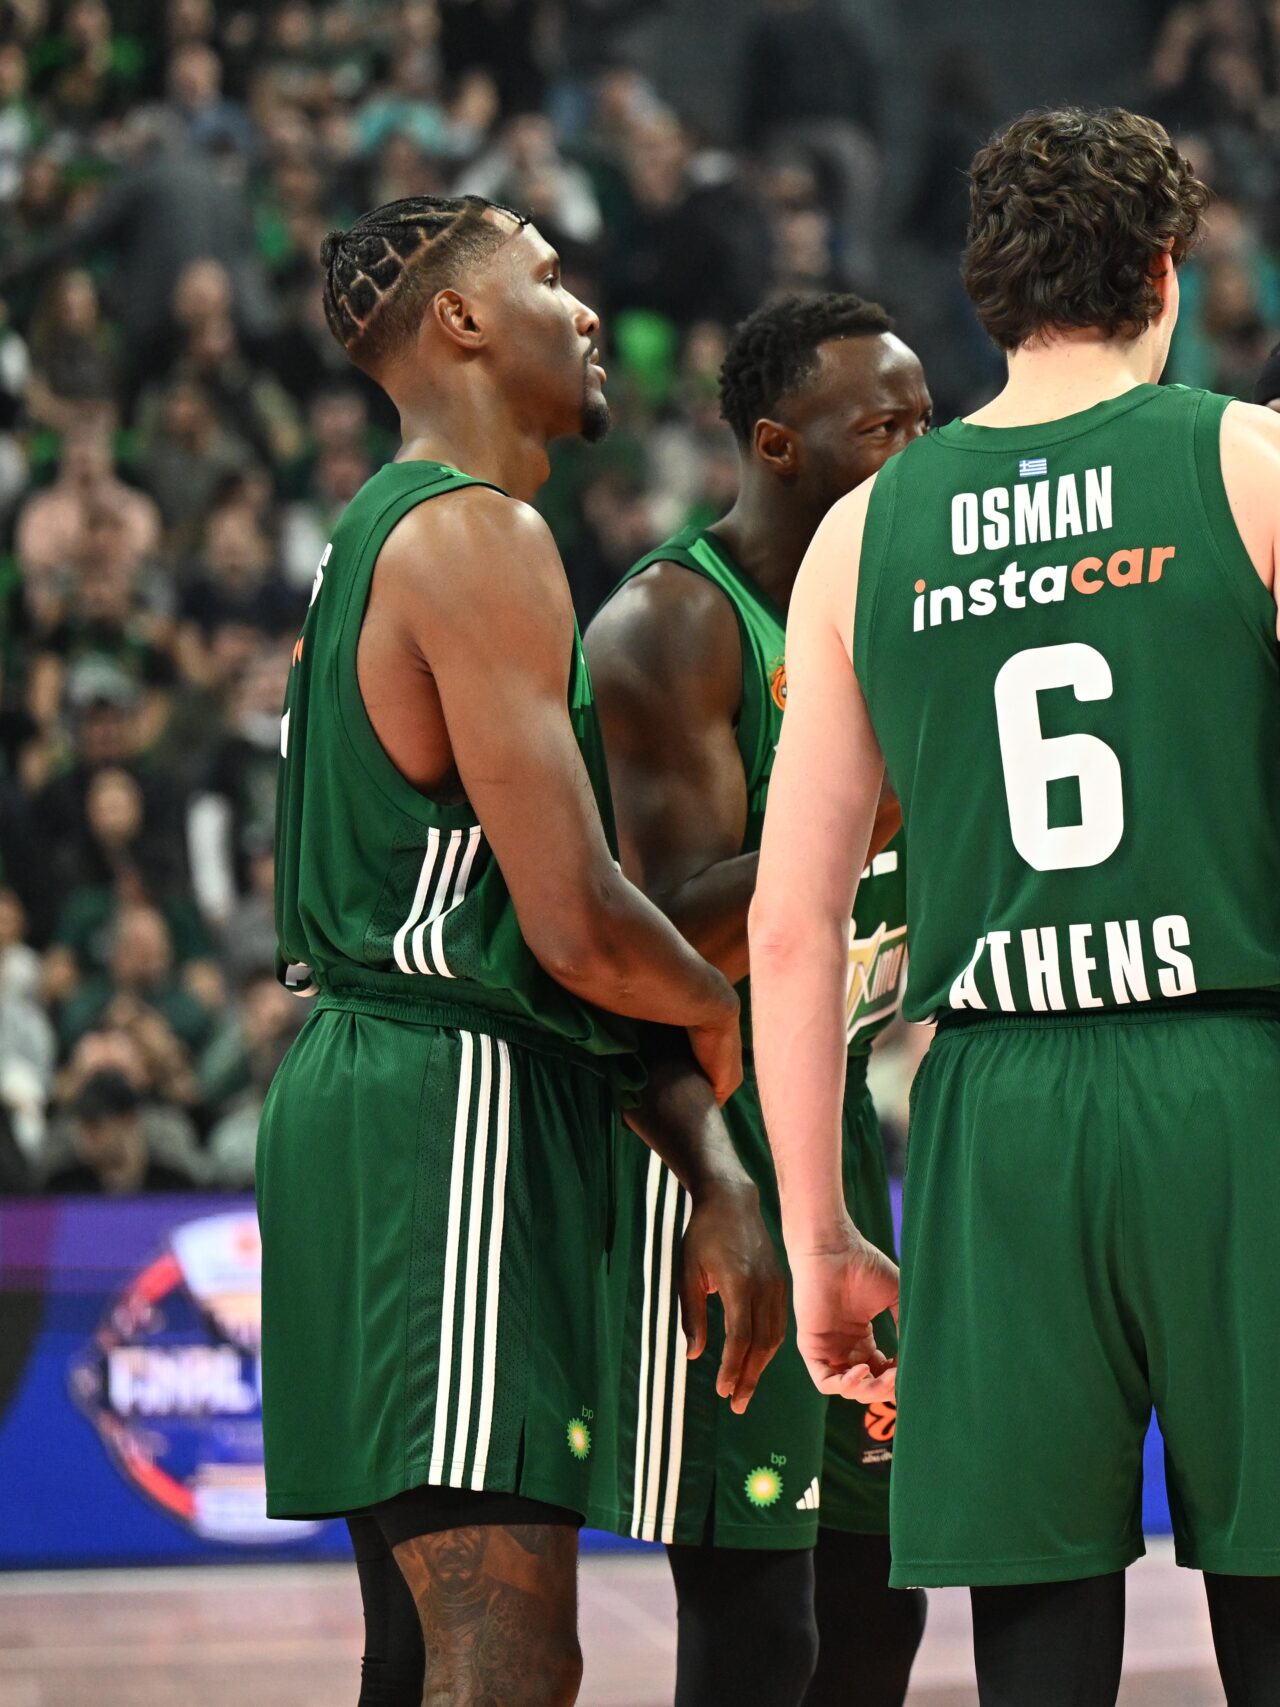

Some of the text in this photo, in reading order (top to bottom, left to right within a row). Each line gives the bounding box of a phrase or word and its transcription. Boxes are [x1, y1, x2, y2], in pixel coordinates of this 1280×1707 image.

[951, 465, 1113, 556] OSMAN
[913, 546, 1176, 633] instacar
[994, 642, 1125, 872] 6
[949, 914, 1197, 1012] ATHENS
[581, 1404, 594, 1421] bp
[770, 1452, 787, 1467] bp
